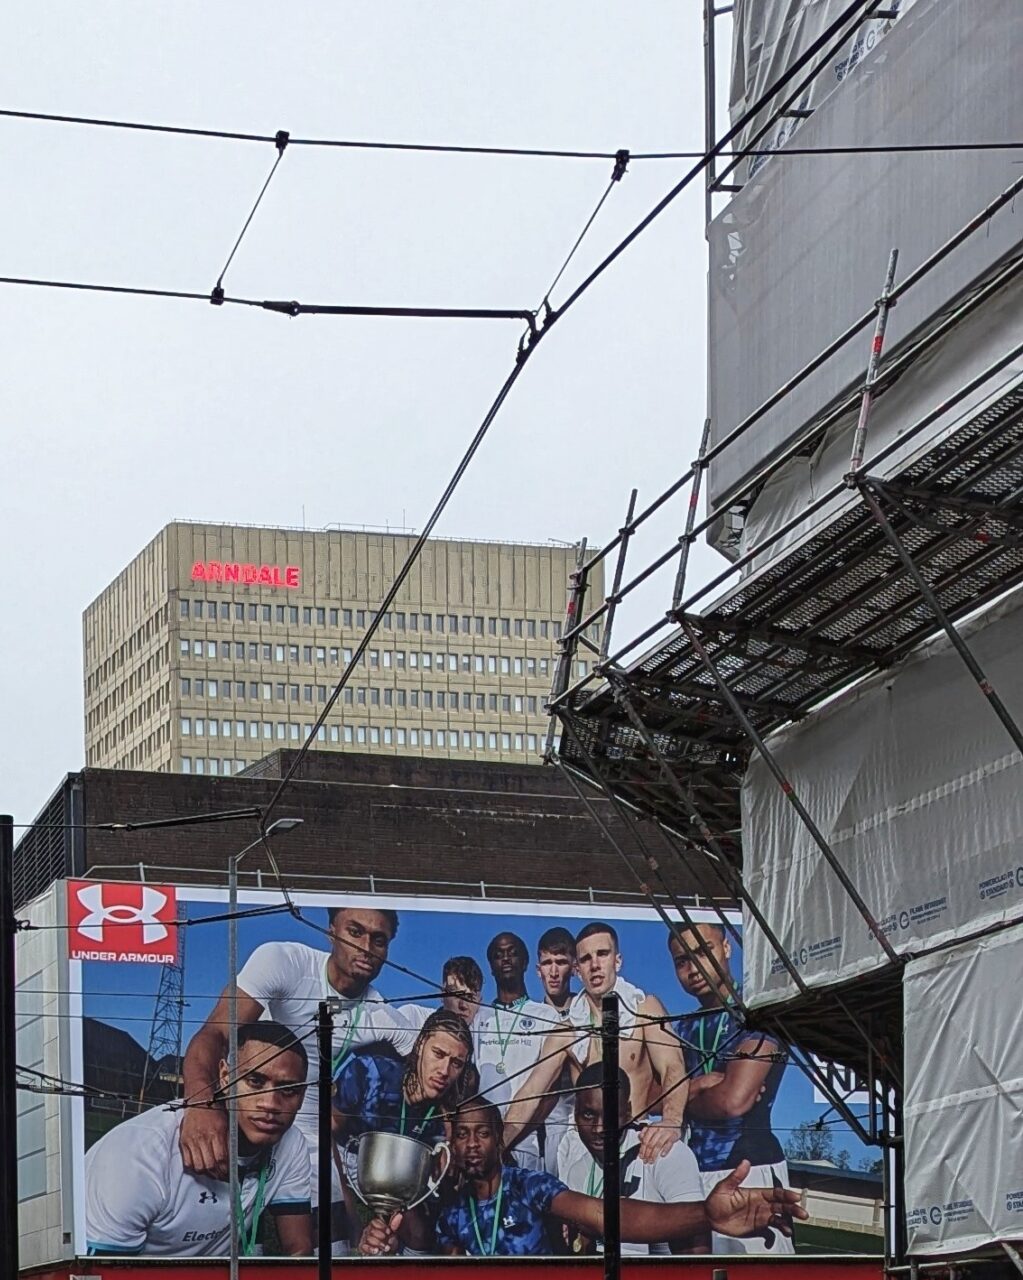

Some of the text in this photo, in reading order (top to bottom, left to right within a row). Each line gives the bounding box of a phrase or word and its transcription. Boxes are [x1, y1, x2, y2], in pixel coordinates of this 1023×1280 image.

[191, 562, 300, 587] ARNDALE
[72, 950, 174, 963] UNDER ARMOUR
